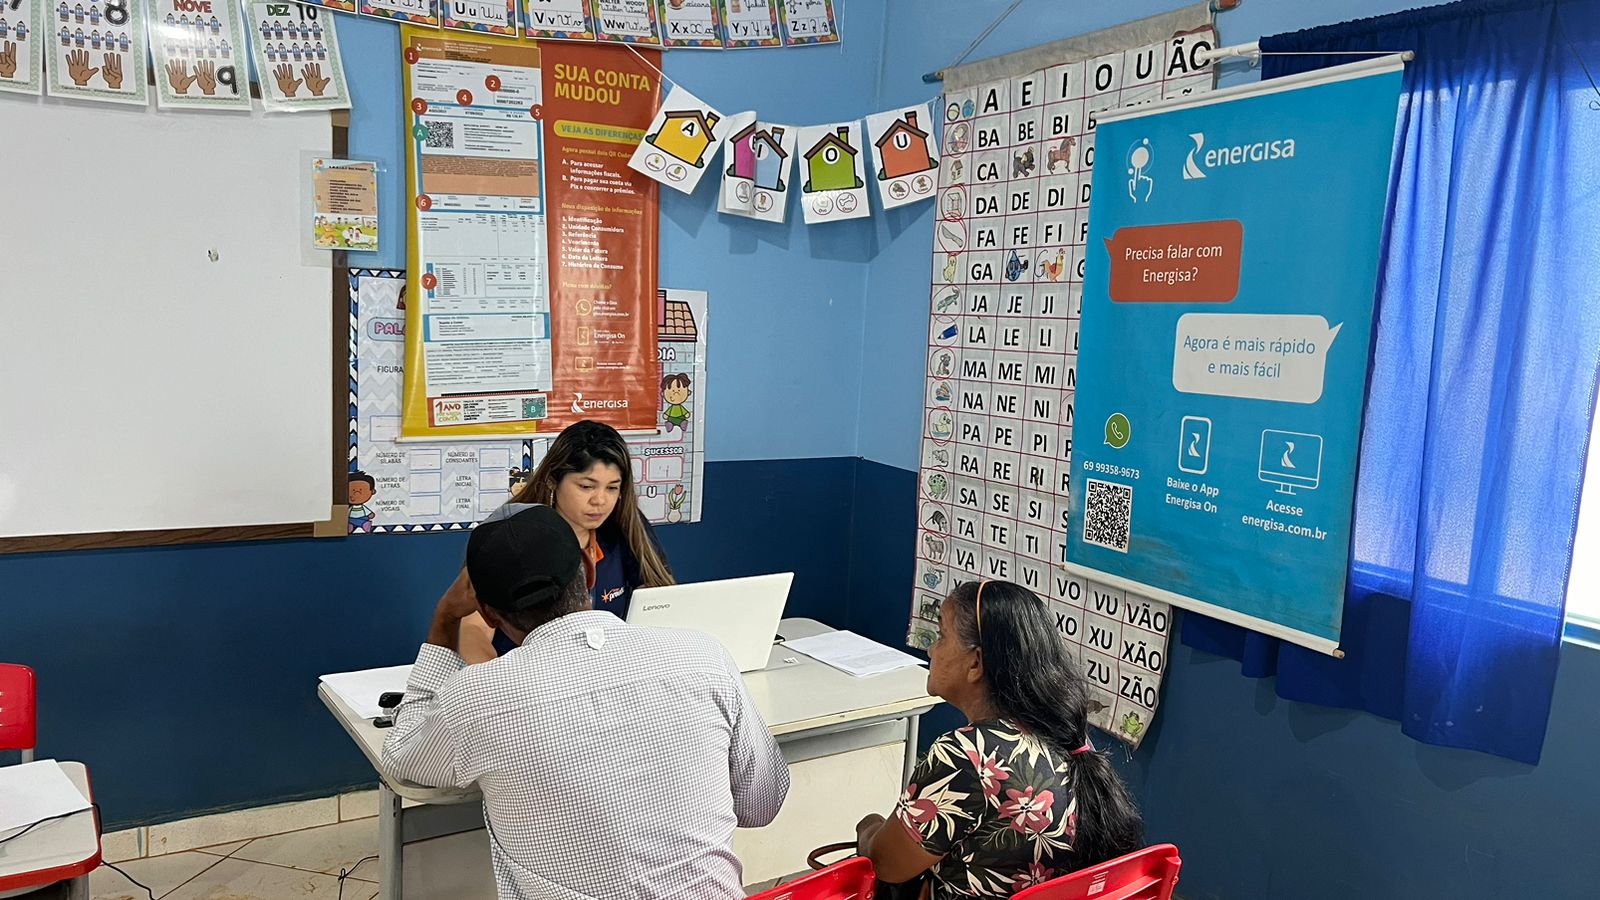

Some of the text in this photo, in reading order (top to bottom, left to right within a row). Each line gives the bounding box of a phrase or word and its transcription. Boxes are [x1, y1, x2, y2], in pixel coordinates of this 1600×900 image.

[104, 0, 130, 26] 8
[174, 0, 213, 13] NOVE
[266, 3, 318, 20] DEZ 10
[455, 2, 477, 16] U u
[534, 12, 545, 24] V
[603, 19, 615, 29] W
[791, 21, 799, 32] Z
[670, 22, 680, 34] X
[731, 22, 749, 36] Y y
[217, 65, 239, 95] 9
[490, 80, 496, 88] 2
[554, 63, 651, 92] SUA CONTA
[983, 37, 1212, 114] A E I O U ÃO
[461, 94, 467, 102] 4
[554, 82, 621, 105] MUDOU
[416, 102, 422, 110] 3
[535, 108, 540, 117] 5
[416, 129, 424, 137] A
[561, 124, 582, 134] VEJA
[583, 126, 594, 136] AS
[682, 121, 696, 137] A
[978, 115, 1069, 148] BA BE BI
[895, 133, 908, 149] U
[826, 149, 838, 162] O
[570, 168, 603, 176] informações
[977, 162, 999, 181] CA
[421, 198, 427, 206] 6
[975, 187, 1065, 215] DA DE DI
[976, 223, 1062, 248] FA FE FI
[1125, 244, 1223, 261] Precisa falar com
[971, 263, 993, 280] GA
[1143, 267, 1198, 285] Energisa?
[425, 278, 431, 286] 7
[971, 295, 1054, 314] JA JE JI
[969, 326, 1052, 347] LA LE LI
[1183, 335, 1316, 356] Agora é mais rápido
[963, 360, 1056, 385] MA ME MI
[1208, 360, 1281, 379] e mais fácil
[443, 403, 461, 411] ANO
[963, 392, 1050, 418] NA NE NI
[962, 423, 1047, 452] PA PE PI
[645, 446, 684, 456] SUCESSOR
[960, 455, 1044, 486] RA RE RI
[1083, 461, 1140, 480] 69 99358-9673
[646, 485, 658, 498] U
[1166, 477, 1219, 498] Baixe o App
[959, 487, 1042, 520] SA SE SI
[1165, 494, 1218, 514] Energisa On
[1265, 499, 1303, 517] Acesse
[957, 518, 1038, 554] TA TE TI
[1242, 515, 1327, 541] energisa.com.br
[956, 548, 1167, 632] VA VE VI VO VU VÃO
[643, 603, 670, 612] Lenovo
[1056, 612, 1162, 671] XO XU XÃO
[1087, 659, 1156, 708] ZU ZÃO
